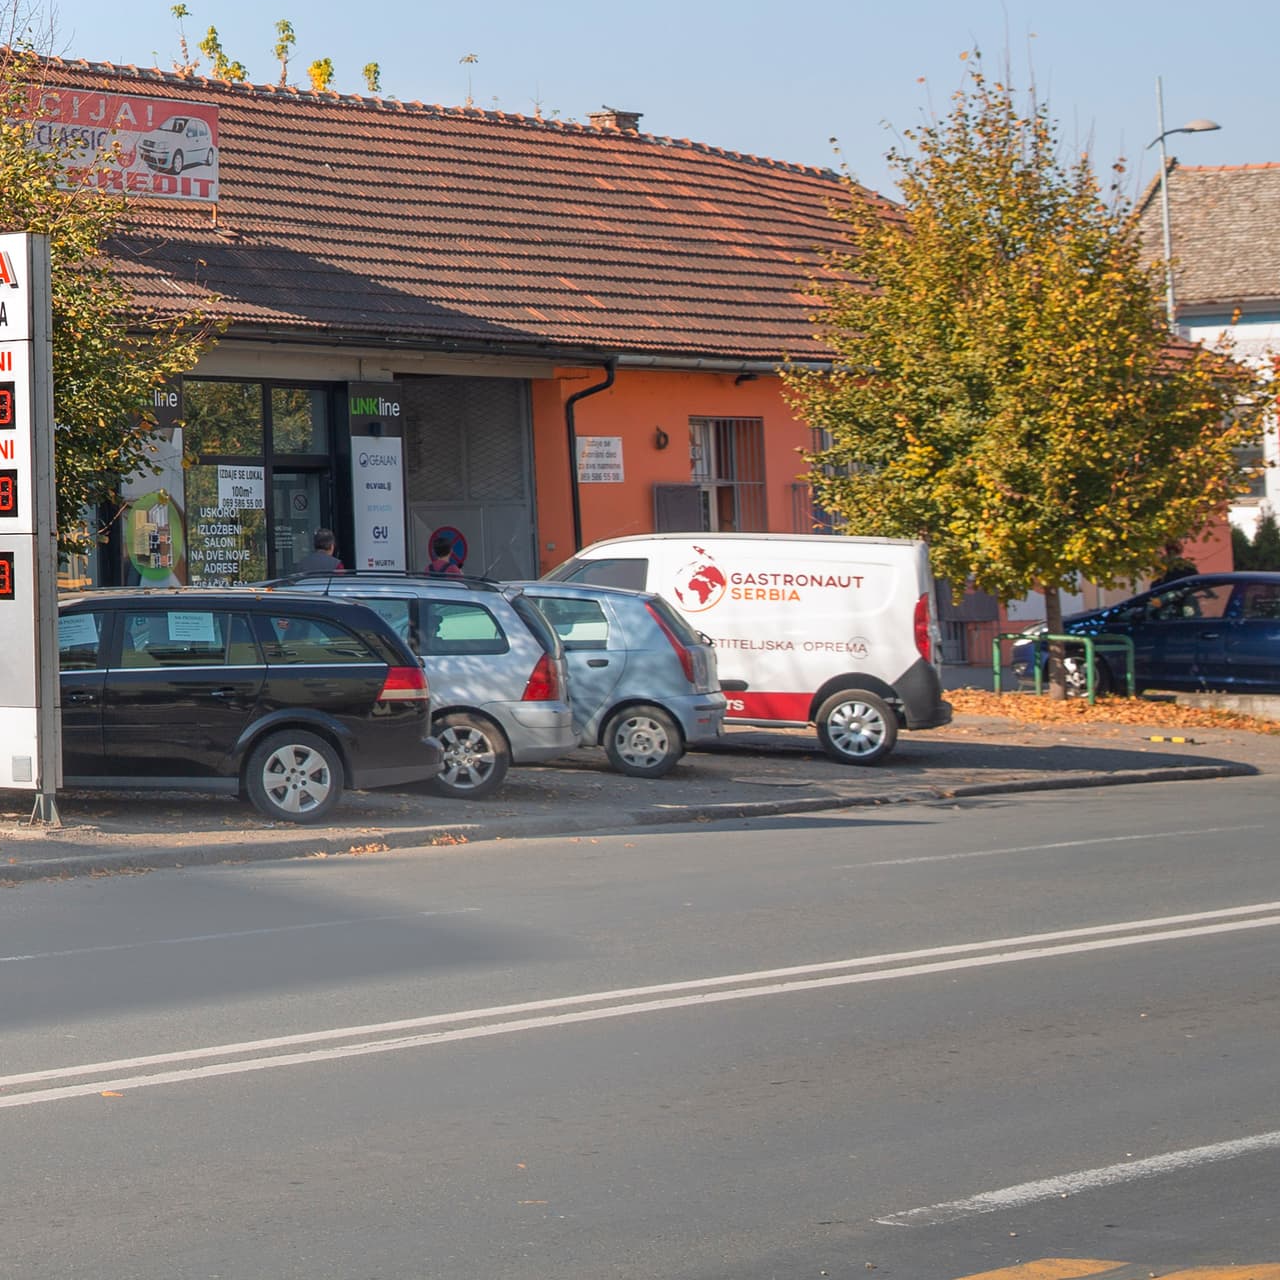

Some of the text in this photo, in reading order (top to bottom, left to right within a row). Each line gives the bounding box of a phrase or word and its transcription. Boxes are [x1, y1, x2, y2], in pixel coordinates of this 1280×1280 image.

[369, 455, 398, 466] GEALAN
[220, 469, 263, 481] IZDAJE SE LOKAL
[246, 498, 253, 508] 55
[255, 498, 263, 508] 00
[198, 522, 242, 535] IZLOŽBENI
[204, 537, 236, 548] SALONI
[191, 550, 250, 560] NA DVE NOVE
[204, 563, 238, 574] ADRESE
[730, 572, 864, 588] GASTRONAUT
[731, 588, 801, 601] SERBIA
[711, 638, 868, 653] STITELJSKA OPREMA
